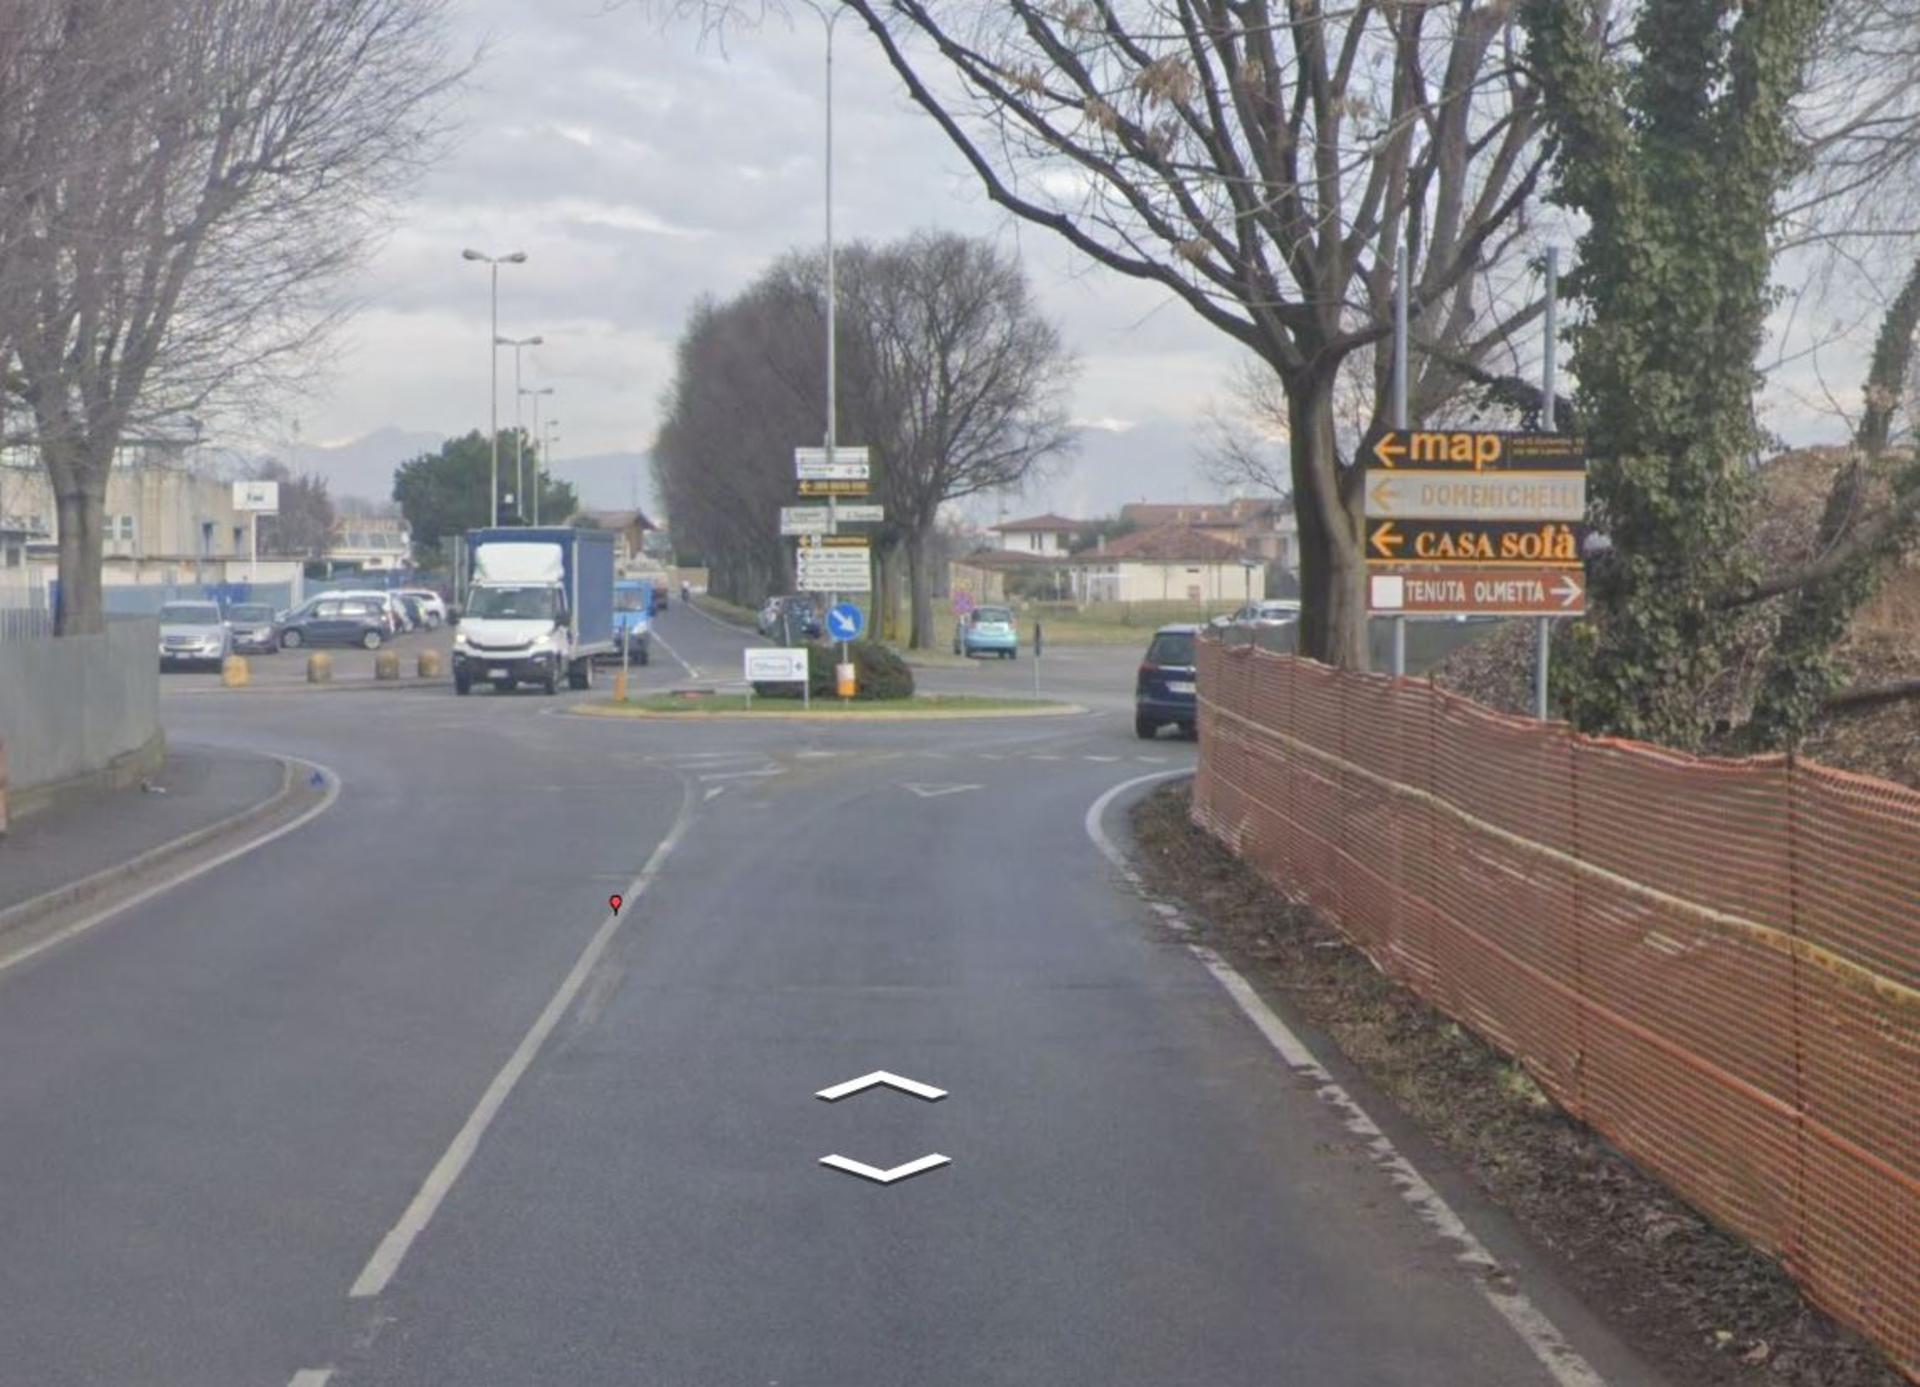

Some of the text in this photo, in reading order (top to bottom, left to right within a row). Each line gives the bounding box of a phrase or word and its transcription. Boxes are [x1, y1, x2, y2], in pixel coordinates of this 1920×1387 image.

[1410, 432, 1502, 472] map
[1420, 483, 1578, 508] DOMENICHELLI
[1415, 531, 1496, 558] CASA
[1406, 579, 1545, 602] TENUTA OLMETTA
